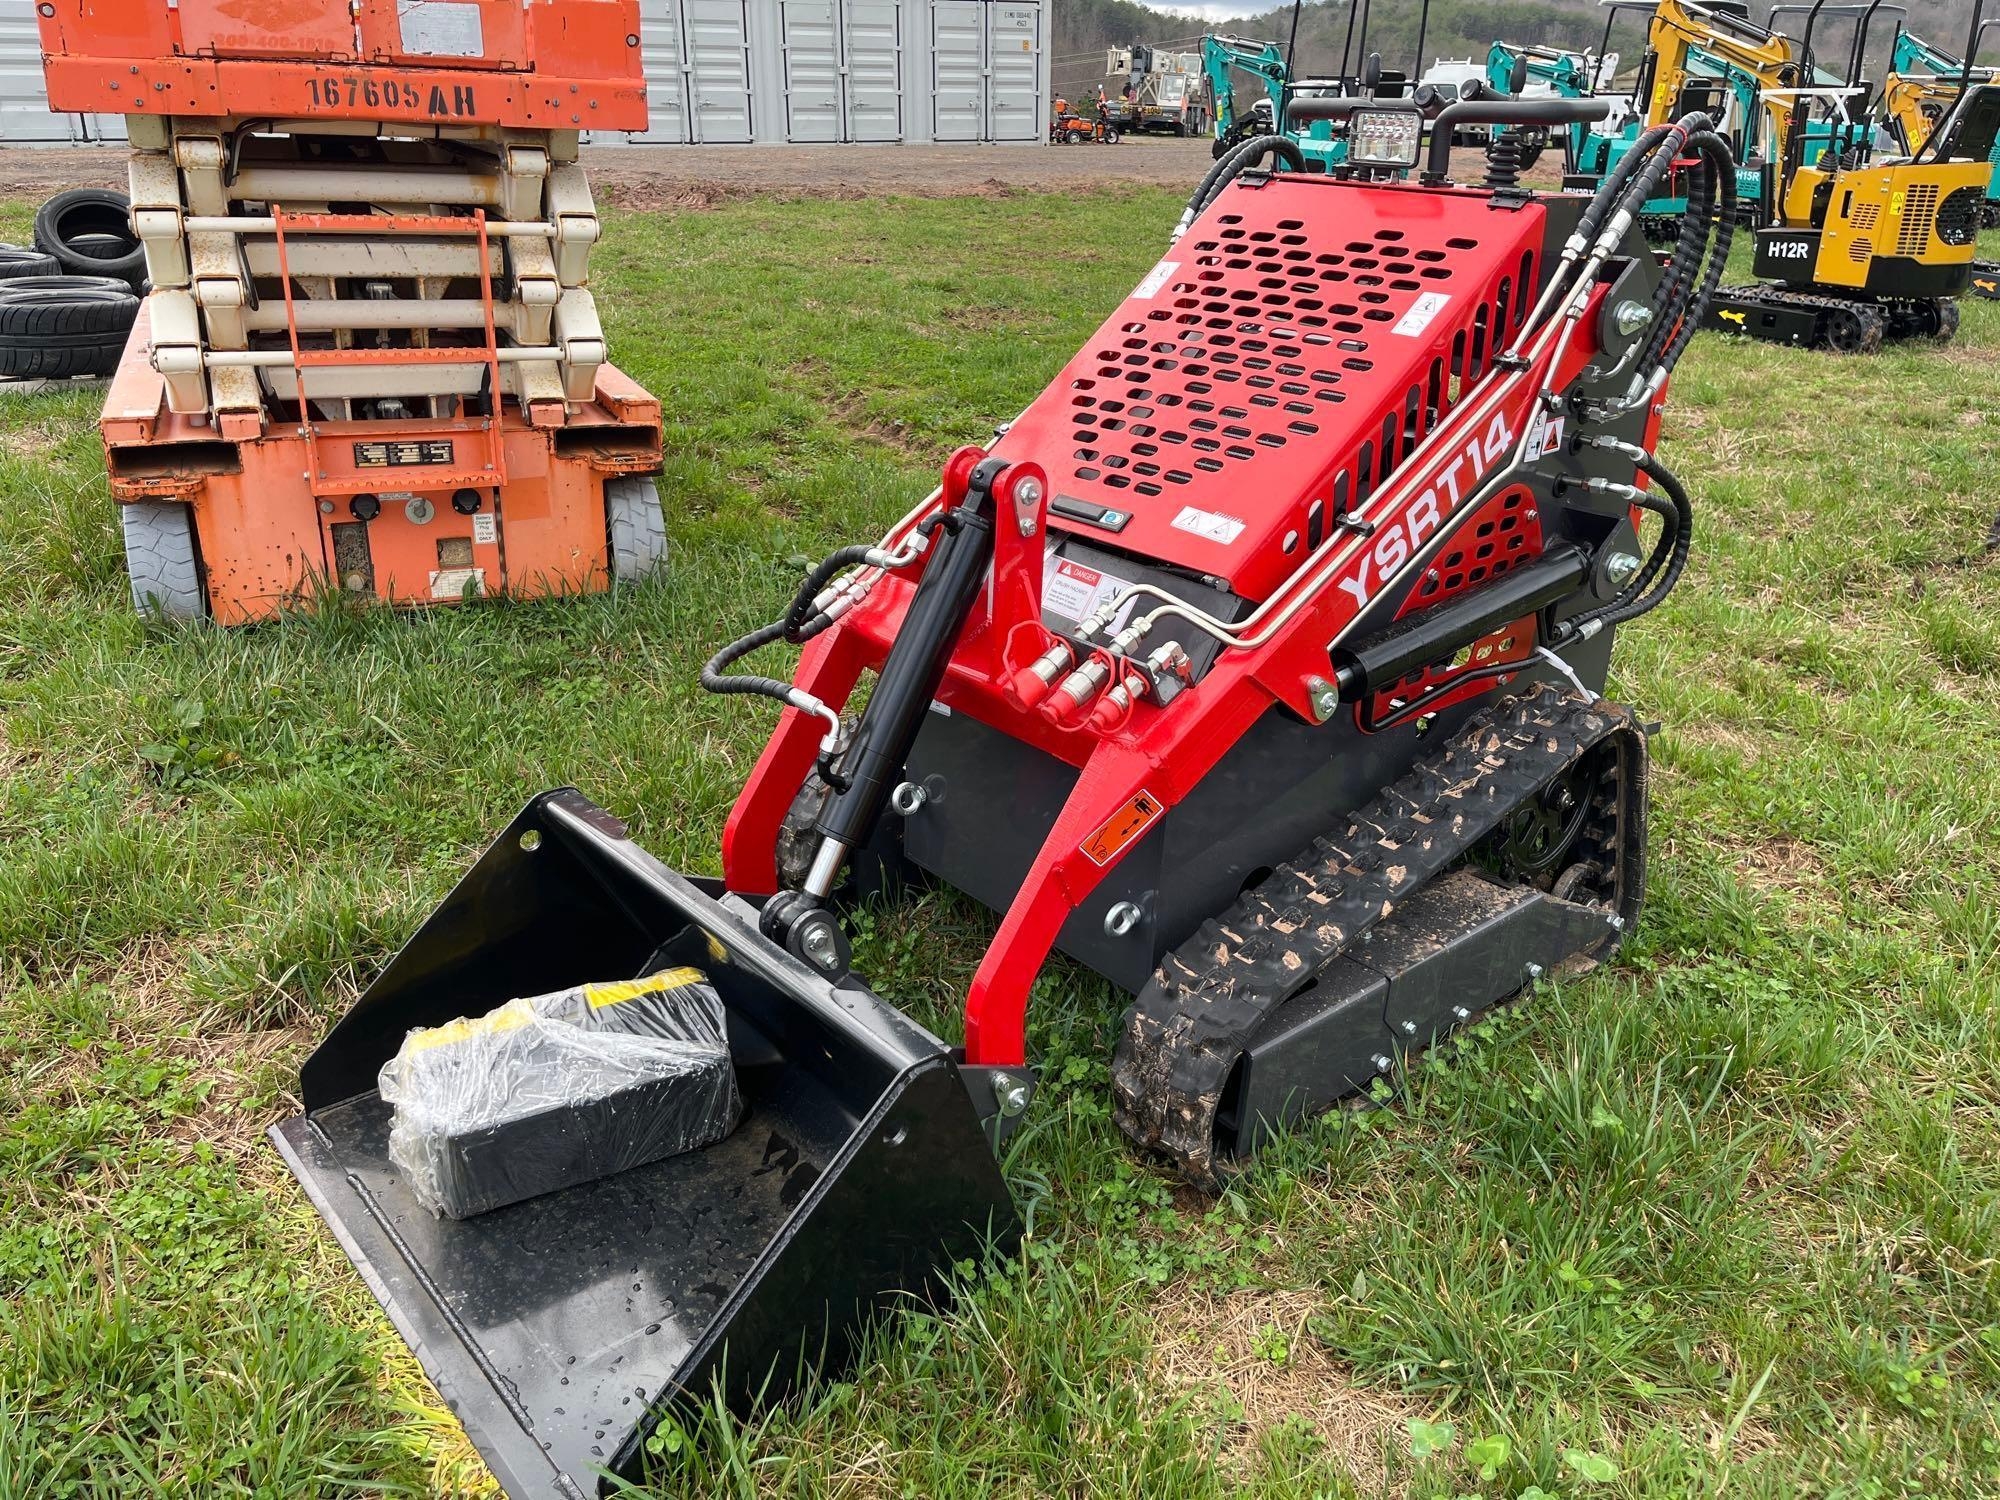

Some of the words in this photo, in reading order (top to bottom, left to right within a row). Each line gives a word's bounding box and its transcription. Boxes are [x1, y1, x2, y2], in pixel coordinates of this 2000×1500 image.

[305, 78, 419, 108] 167605
[428, 85, 475, 116] AH
[1736, 170, 1760, 181] H15R
[1768, 241, 1808, 258] H12R
[1338, 410, 1513, 609] YSRT14
[1073, 568, 1097, 583] DANGER
